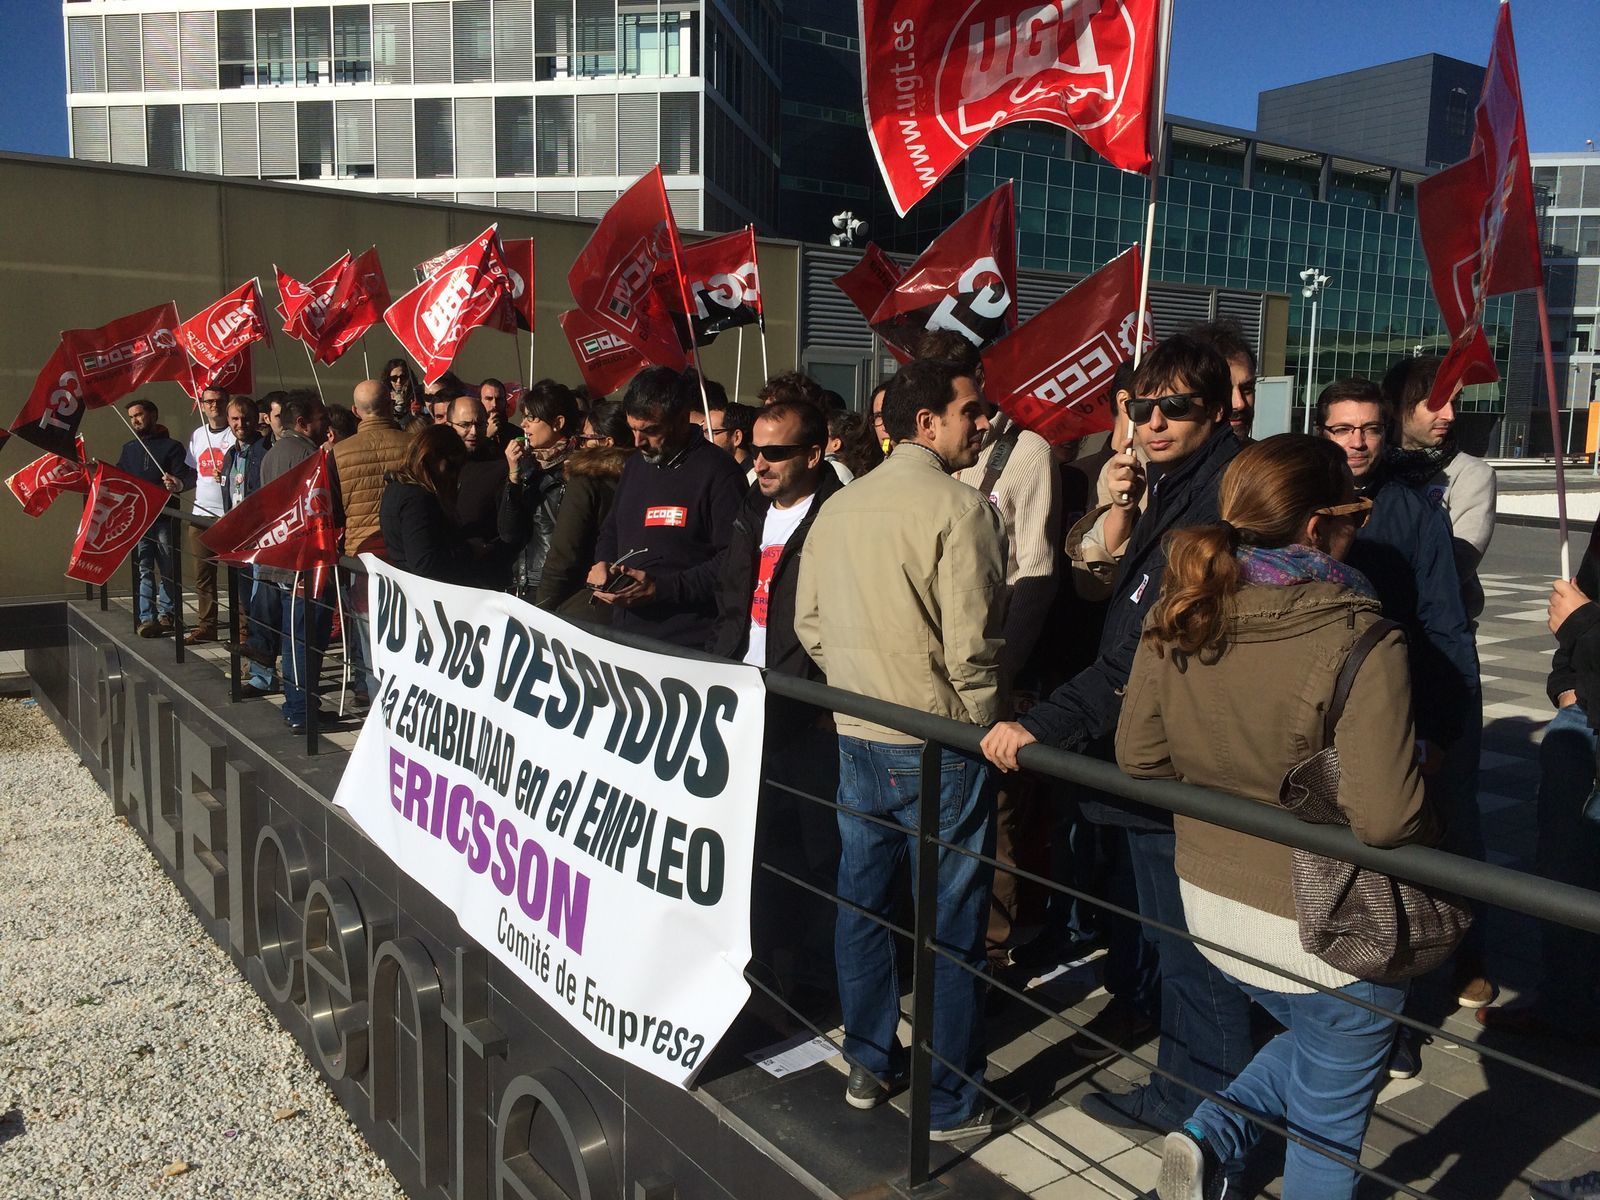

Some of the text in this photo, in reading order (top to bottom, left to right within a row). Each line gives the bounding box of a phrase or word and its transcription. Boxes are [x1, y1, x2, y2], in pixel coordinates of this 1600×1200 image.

[890, 18, 937, 190] www.ugt.es
[961, 0, 1102, 100] UGT
[415, 608, 434, 666] a
[433, 600, 491, 688] los
[494, 615, 738, 798] DESPIDOS
[390, 746, 590, 957] ERICSSON
[395, 684, 515, 797] ESTABILIDAD
[515, 759, 549, 820] en
[546, 770, 587, 838] el
[573, 778, 725, 906] EMPLEO
[497, 906, 550, 983] Comité
[555, 958, 577, 1005] de
[582, 976, 705, 1070] Empresa
